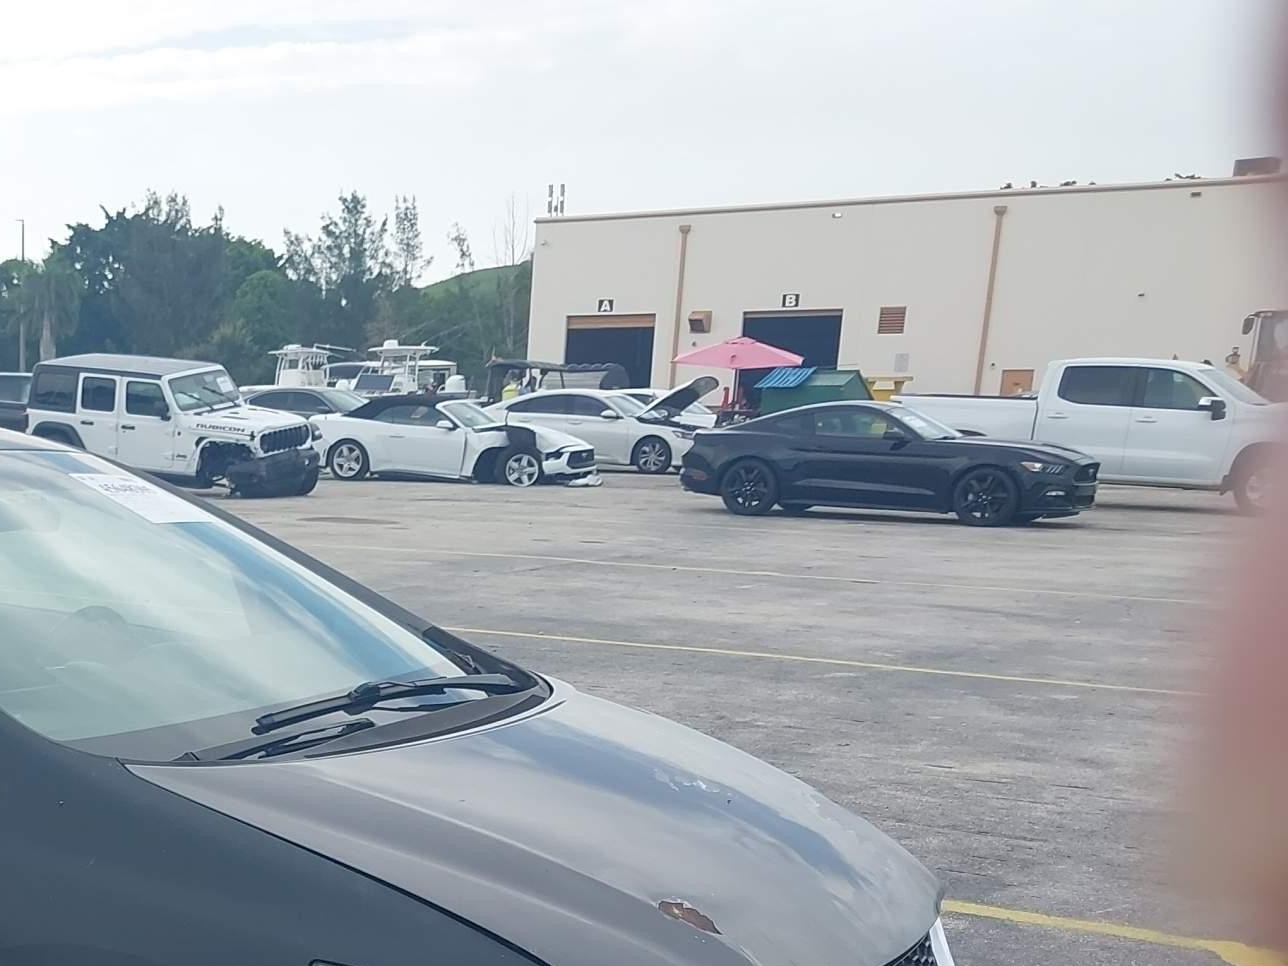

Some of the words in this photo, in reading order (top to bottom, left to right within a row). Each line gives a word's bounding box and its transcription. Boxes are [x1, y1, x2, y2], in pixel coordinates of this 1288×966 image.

[785, 294, 797, 307] B
[600, 301, 612, 312] A
[196, 423, 245, 433] RUBICON
